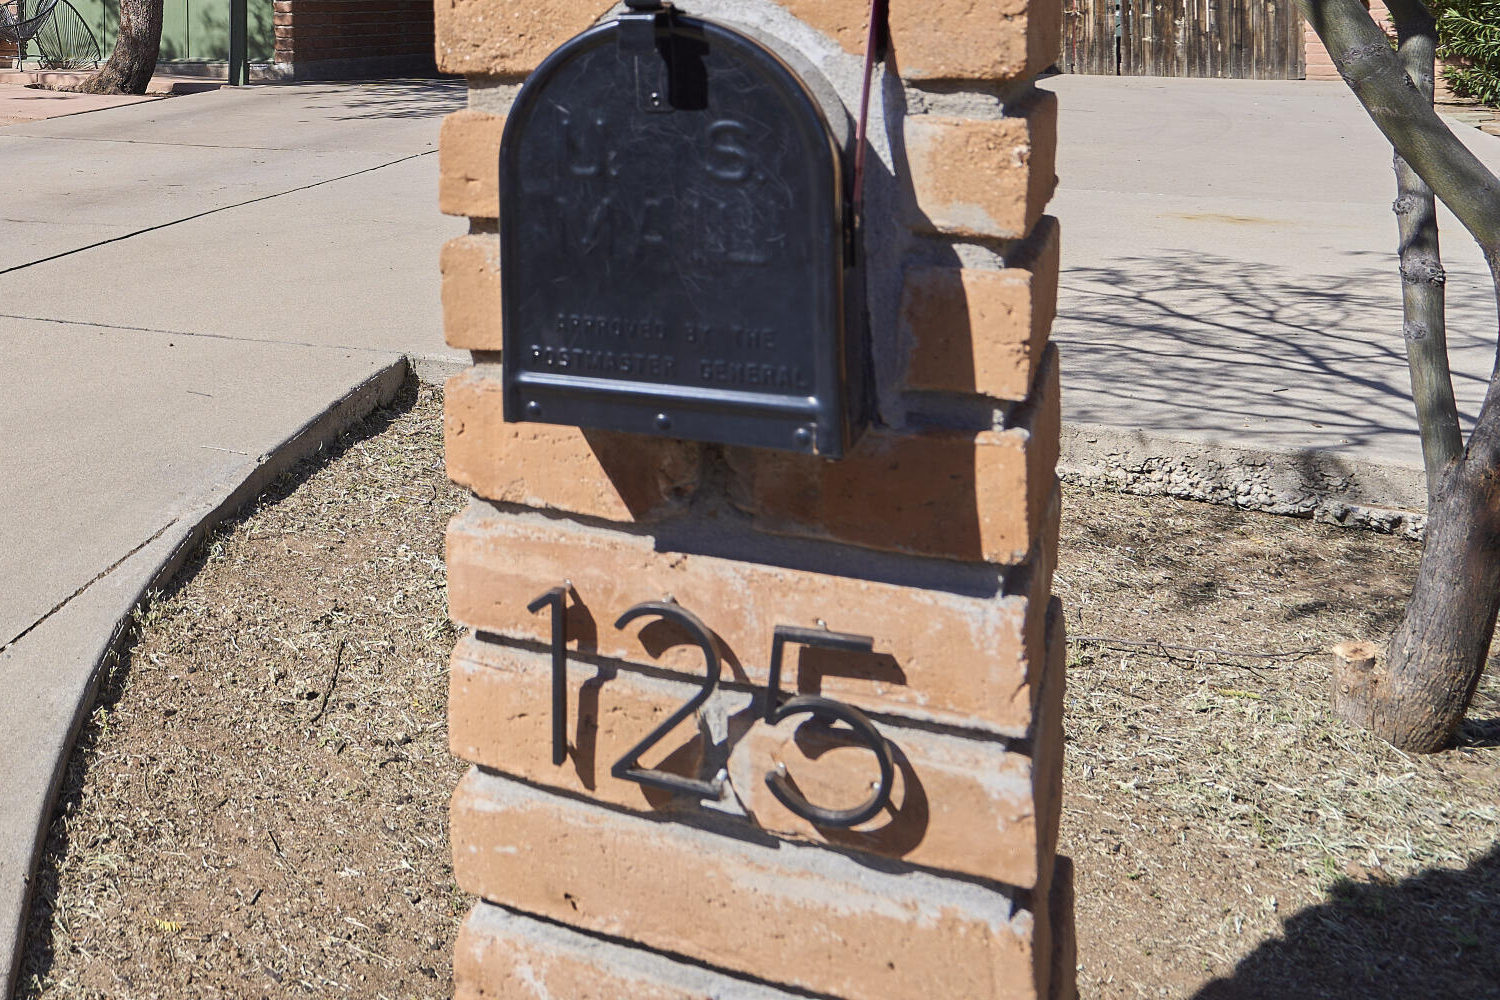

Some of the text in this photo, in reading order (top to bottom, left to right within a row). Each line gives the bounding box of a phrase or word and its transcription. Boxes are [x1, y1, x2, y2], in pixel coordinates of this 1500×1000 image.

[556, 312, 779, 350] APPROVED BY THE
[529, 343, 807, 389] POSTMASTER GENERAL
[527, 586, 894, 829] 125
